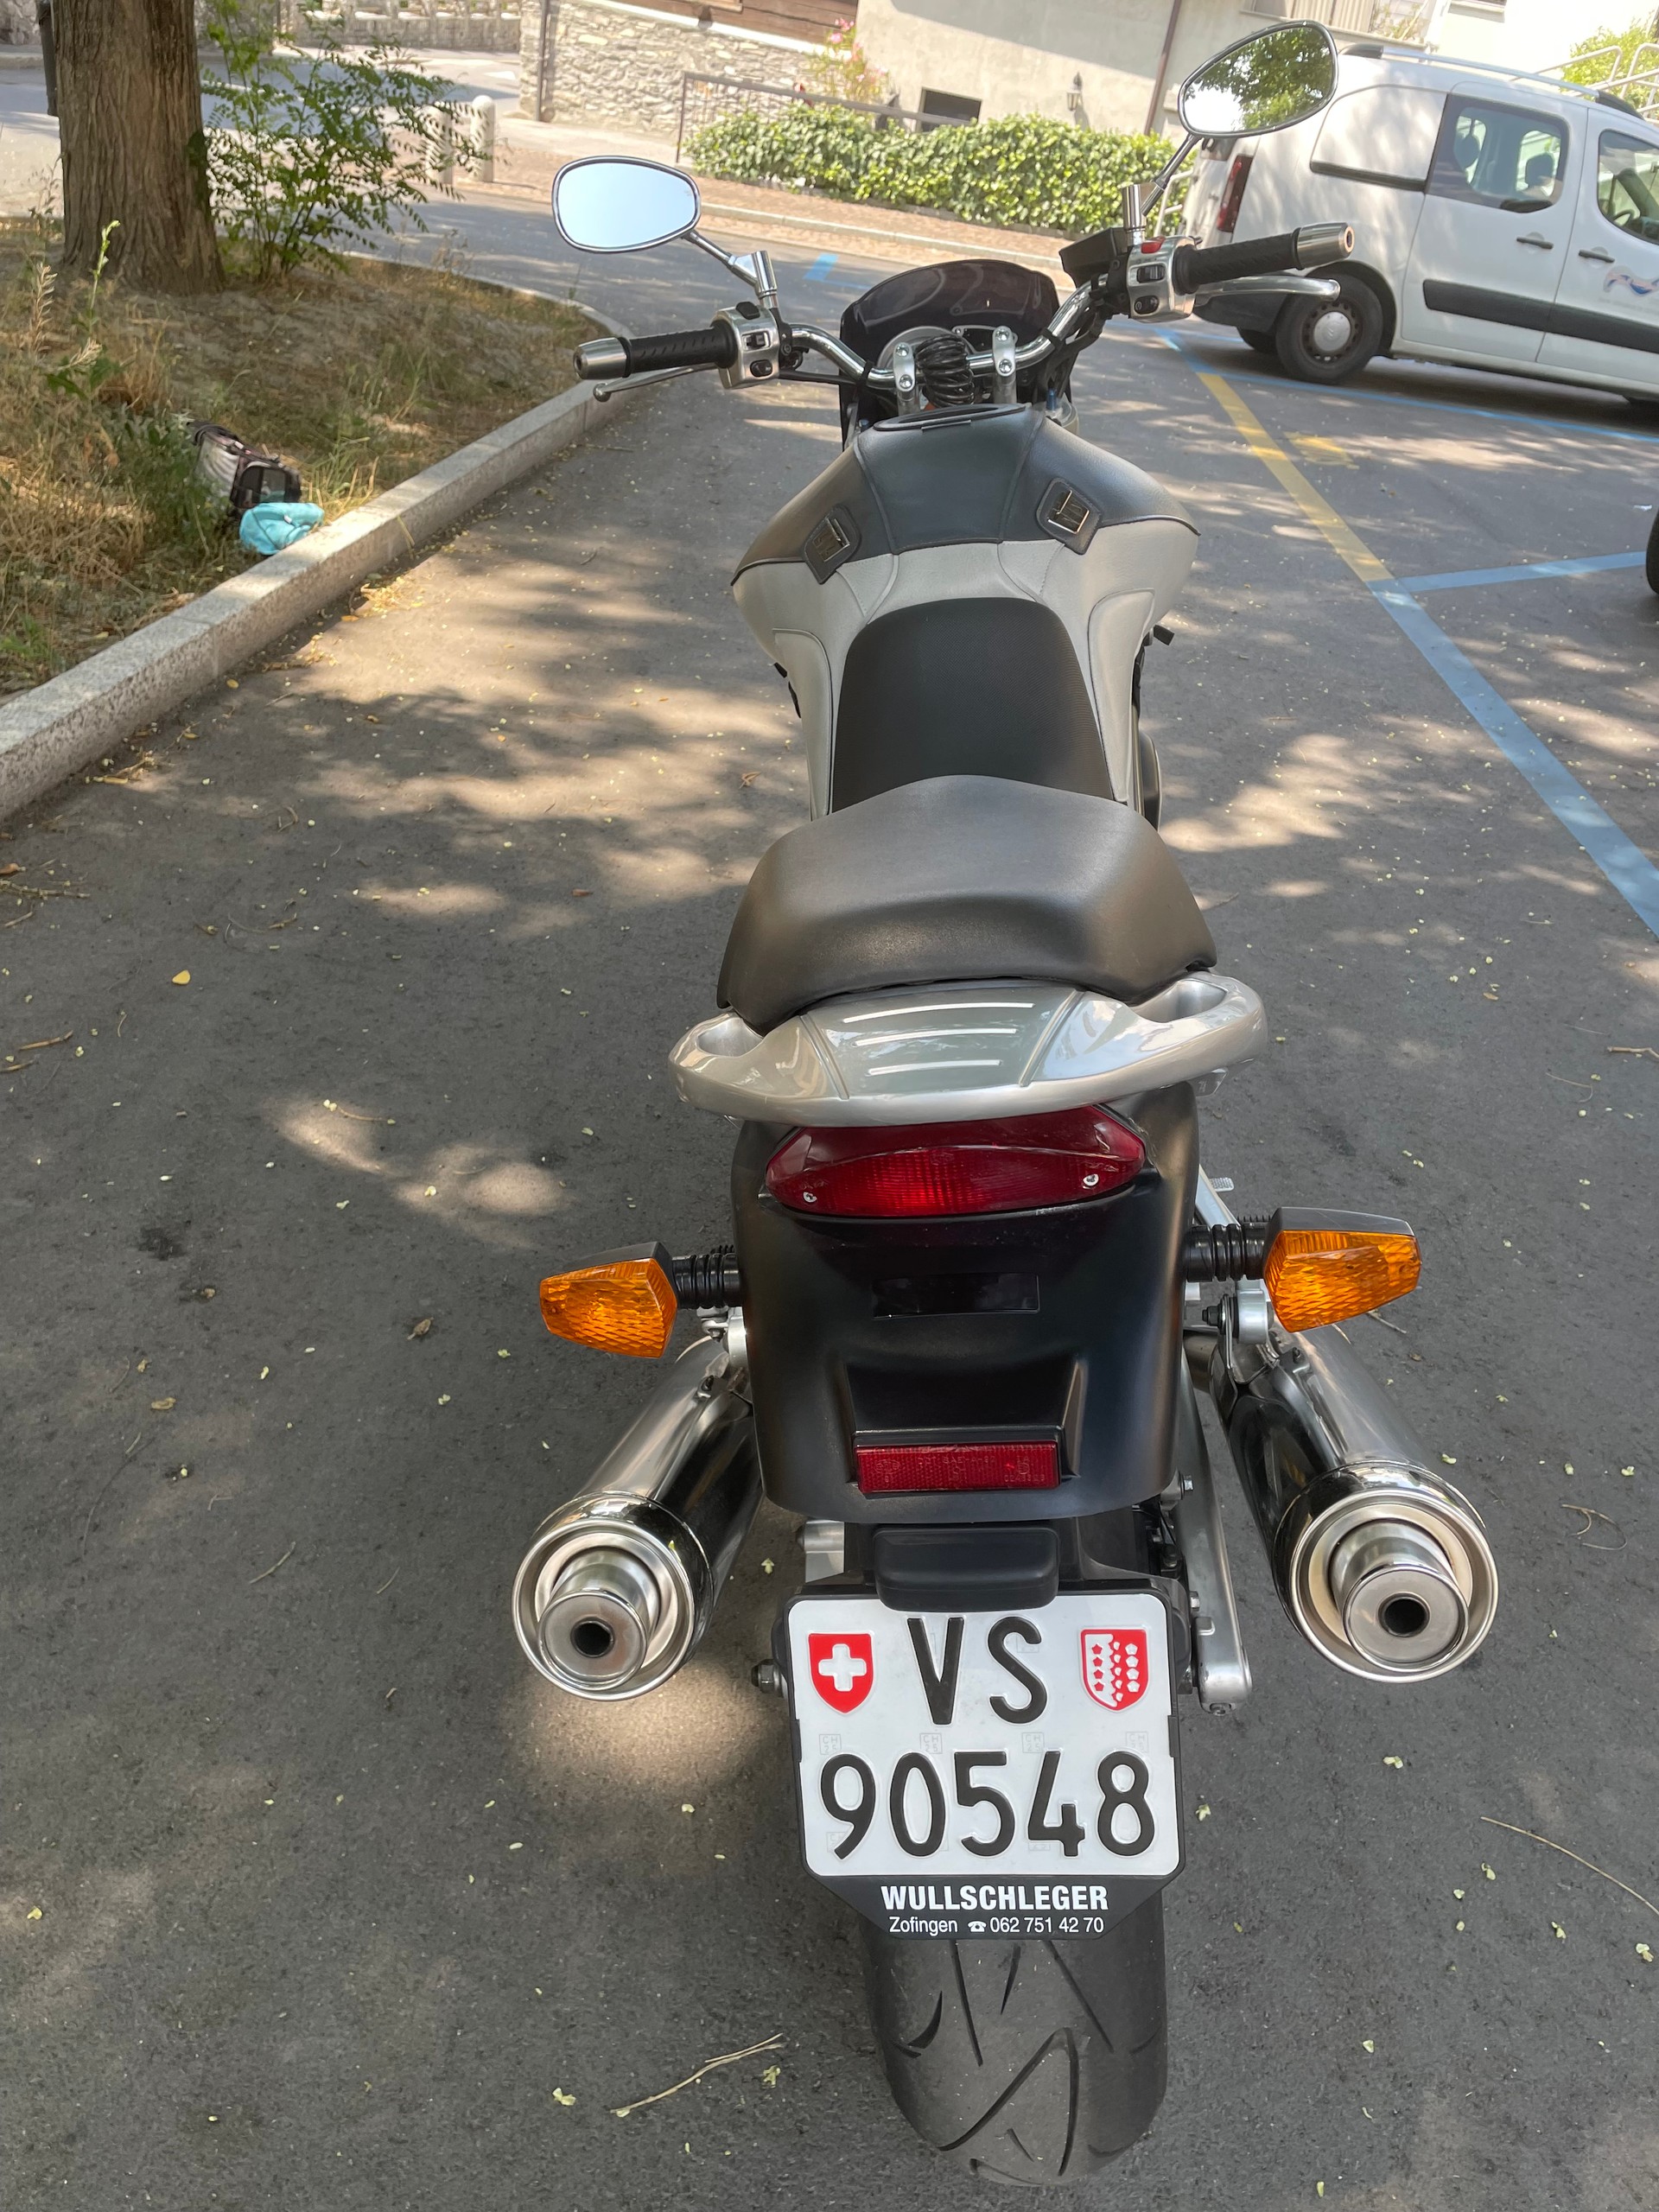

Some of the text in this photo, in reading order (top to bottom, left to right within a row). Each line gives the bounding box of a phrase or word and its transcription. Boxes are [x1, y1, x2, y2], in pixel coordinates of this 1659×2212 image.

[907, 1616, 1047, 1725] VS
[923, 1734, 938, 1743] CH
[1025, 1733, 1041, 1742] CH
[1129, 1732, 1145, 1741] CH
[821, 1751, 1155, 1859] 90548
[880, 1885, 1109, 1910] WULLSCHLEGER
[889, 1916, 1104, 1936] Zofingen 062 751 42 70
